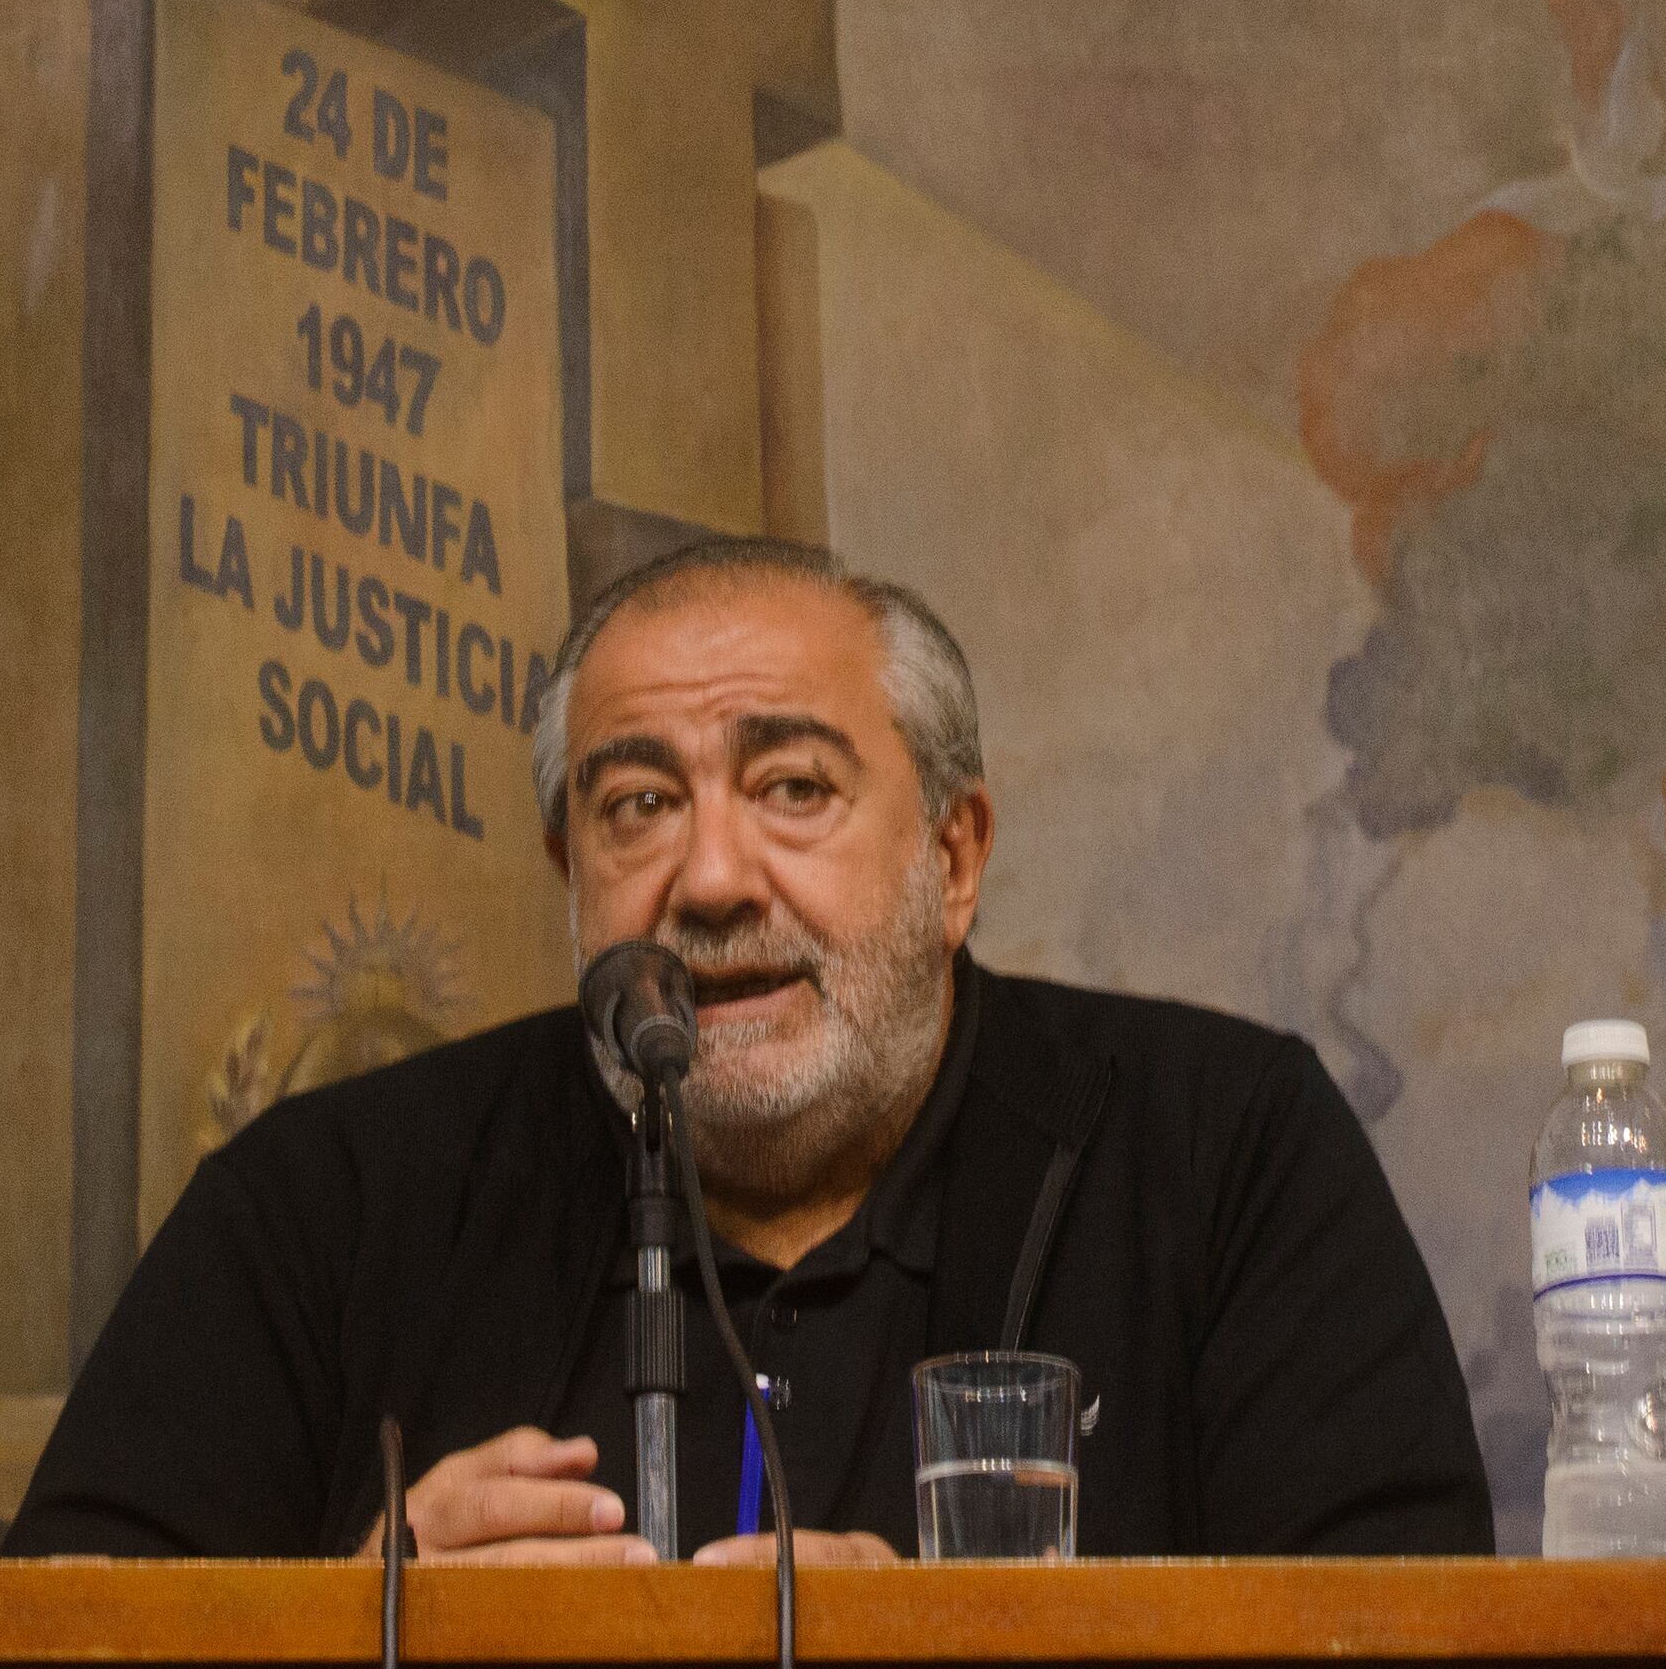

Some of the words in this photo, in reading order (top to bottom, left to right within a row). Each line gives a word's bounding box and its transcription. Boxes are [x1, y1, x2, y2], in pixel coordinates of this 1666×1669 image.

[282, 52, 352, 157] 24
[374, 89, 449, 200] DE
[227, 145, 505, 347] FEBRERO
[297, 303, 442, 436] 1947
[179, 496, 254, 609] LA
[231, 395, 501, 595] TRIUNFA
[258, 661, 484, 841] SOCIAL
